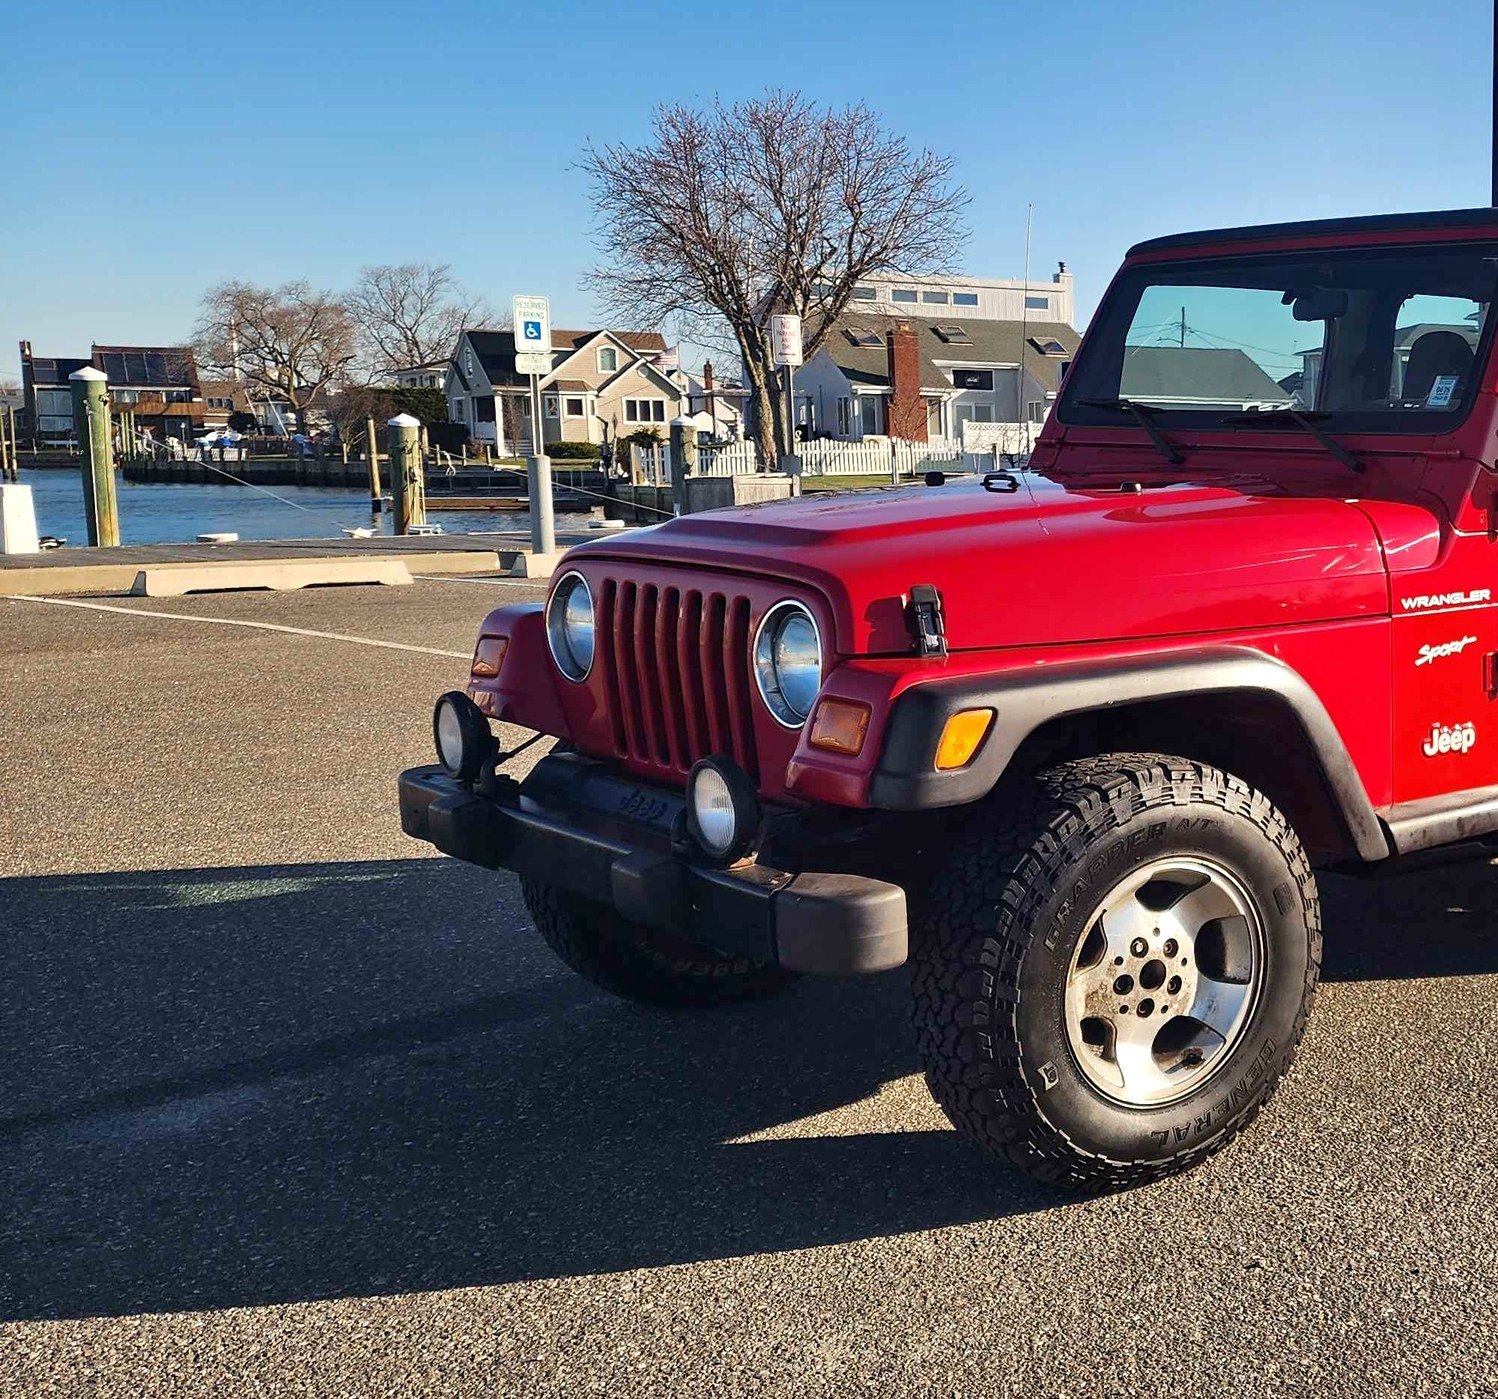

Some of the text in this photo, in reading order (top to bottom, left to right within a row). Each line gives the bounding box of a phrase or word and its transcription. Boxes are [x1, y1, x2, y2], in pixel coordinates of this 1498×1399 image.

[515, 300, 546, 311] RESERVED
[518, 310, 545, 320] PARKING
[780, 320, 791, 330] NO
[1401, 589, 1491, 610] WRANGLER
[1414, 636, 1478, 667] Sport
[1422, 723, 1476, 757] Jeep
[1044, 821, 1168, 952] GRABBER
[1150, 1037, 1277, 1148] GENERAL
